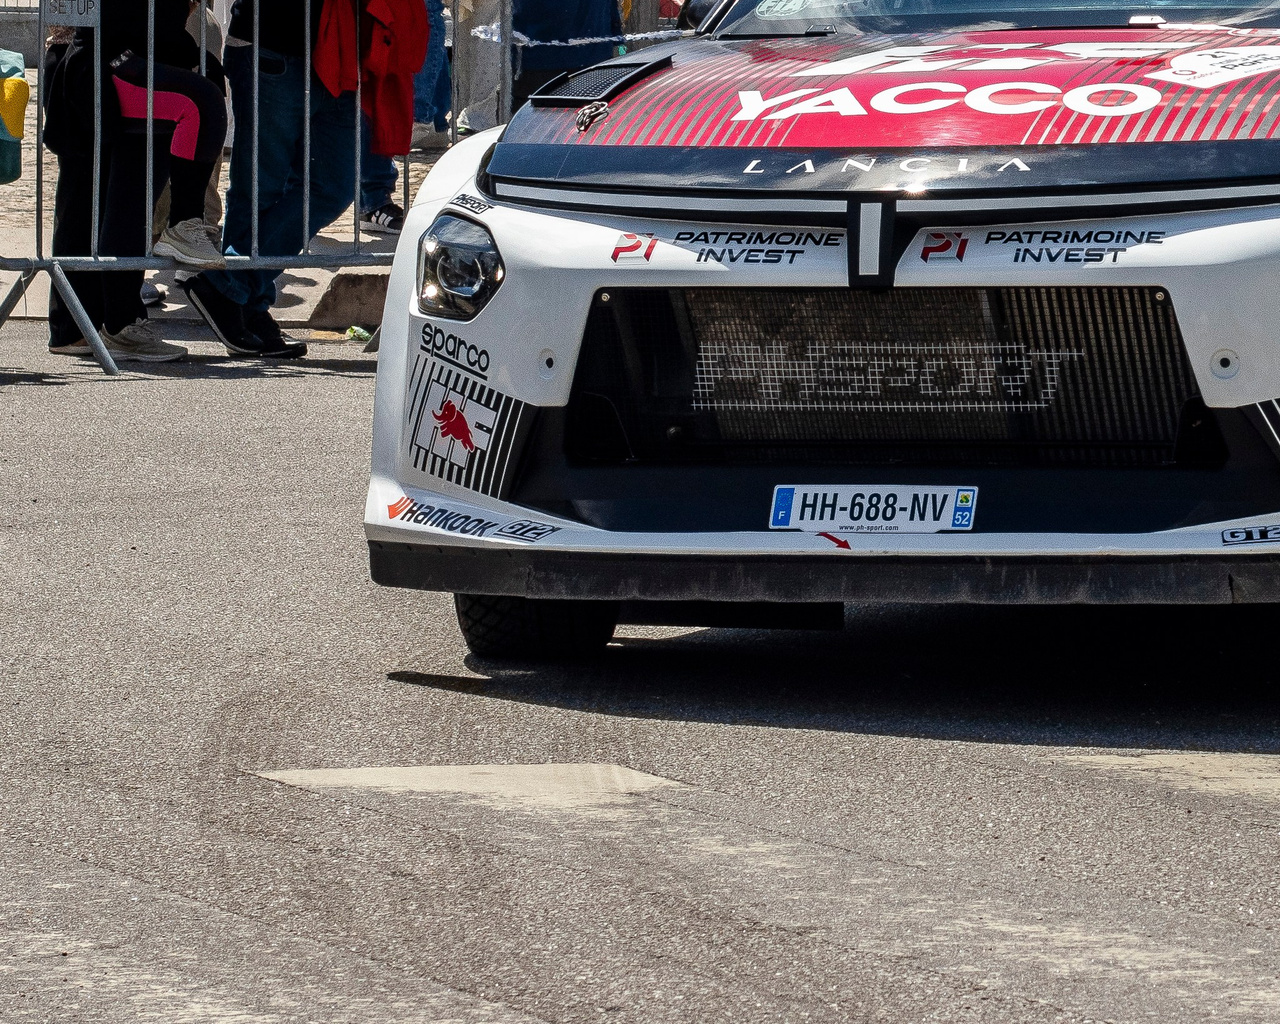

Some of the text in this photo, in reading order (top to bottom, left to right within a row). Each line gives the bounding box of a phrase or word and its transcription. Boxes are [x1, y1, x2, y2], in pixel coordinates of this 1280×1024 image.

[731, 82, 1162, 121] YACCO
[743, 157, 1031, 174] LANCIA
[421, 323, 490, 373] sparco
[778, 492, 970, 525] F HH-688-NV 52
